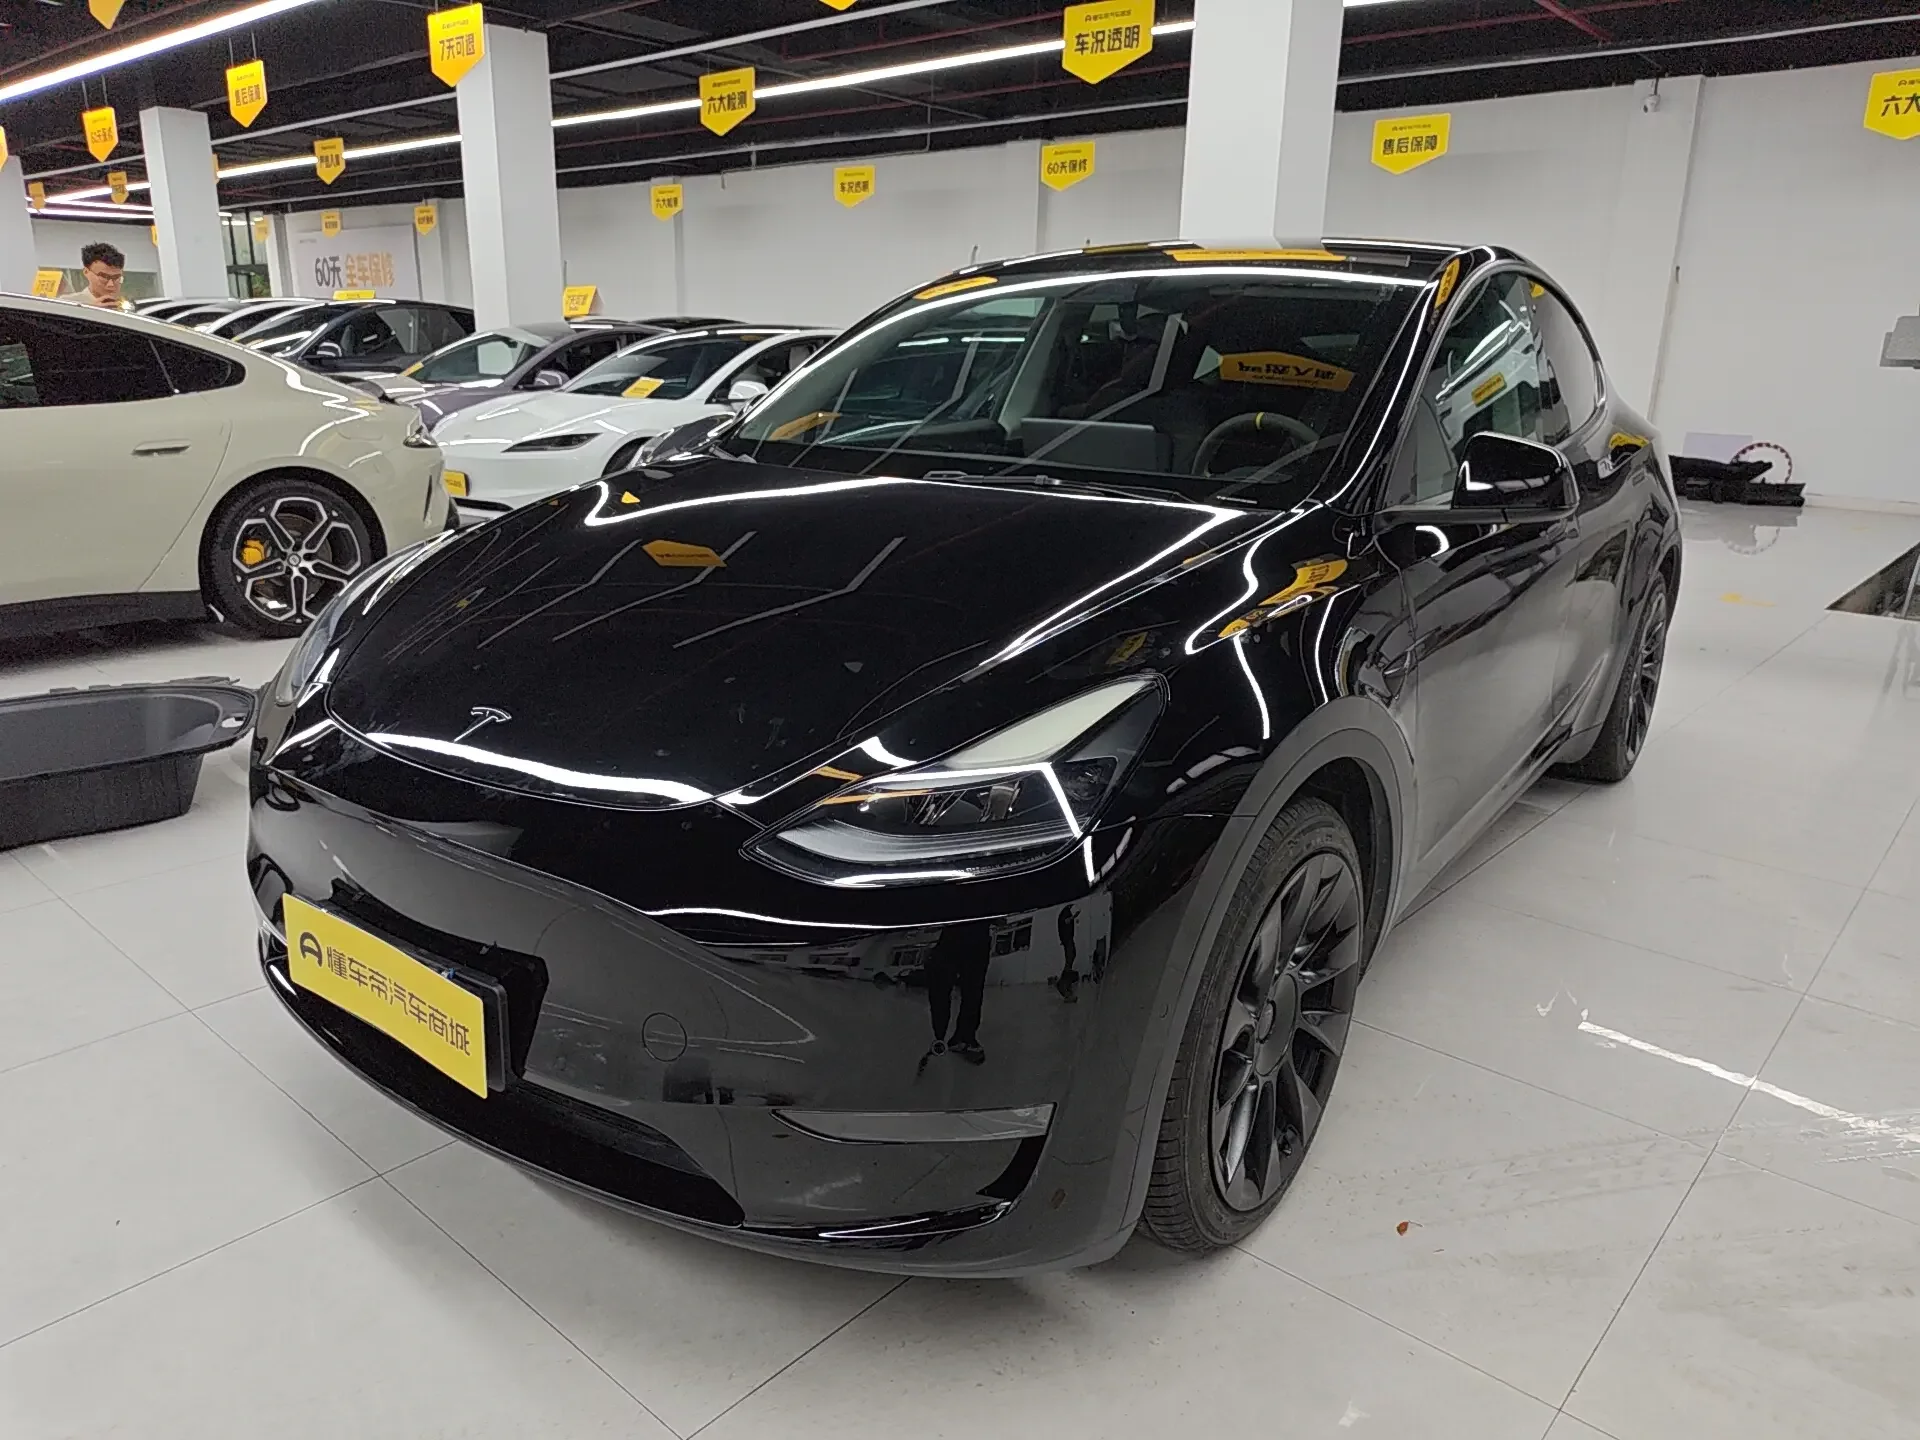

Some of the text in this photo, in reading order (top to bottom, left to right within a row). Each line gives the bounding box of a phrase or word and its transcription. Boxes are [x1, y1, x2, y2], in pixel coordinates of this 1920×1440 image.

[439, 33, 475, 61] 7天可退
[1074, 24, 1140, 55] 车况透明
[707, 90, 747, 115] 六大检测
[1881, 93, 1920, 117] 六大
[1383, 134, 1438, 155] 售后保障
[1047, 158, 1087, 175] 60天保修
[840, 180, 869, 194] 车况透明
[315, 252, 395, 288] 60天 全车保修
[326, 945, 471, 1057] 懂车帝汽车商城
